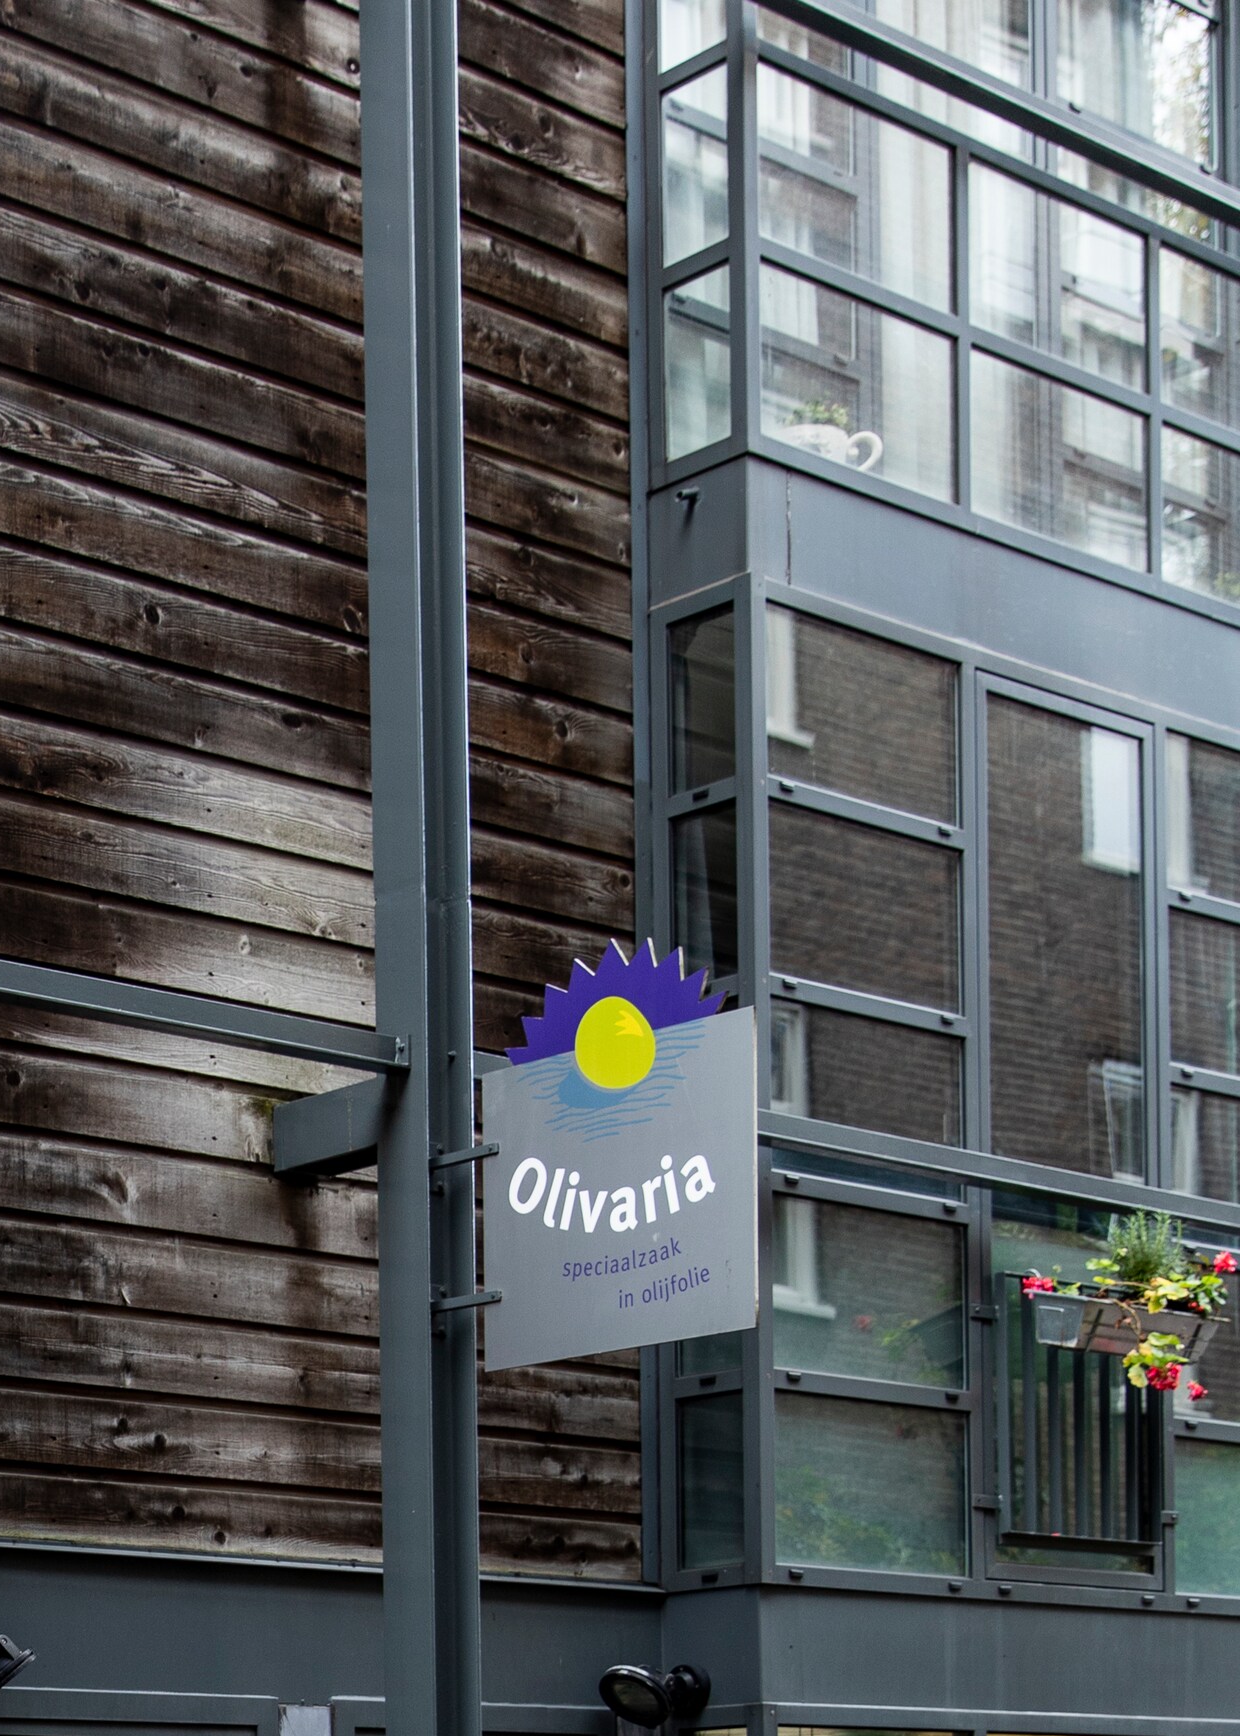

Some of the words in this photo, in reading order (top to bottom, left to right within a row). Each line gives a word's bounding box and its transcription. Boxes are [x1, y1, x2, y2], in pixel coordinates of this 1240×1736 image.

[508, 1155, 716, 1234] Olivaria
[562, 1237, 681, 1282] speciaalzaak
[618, 1289, 635, 1310] in
[642, 1265, 711, 1305] olijfolie
